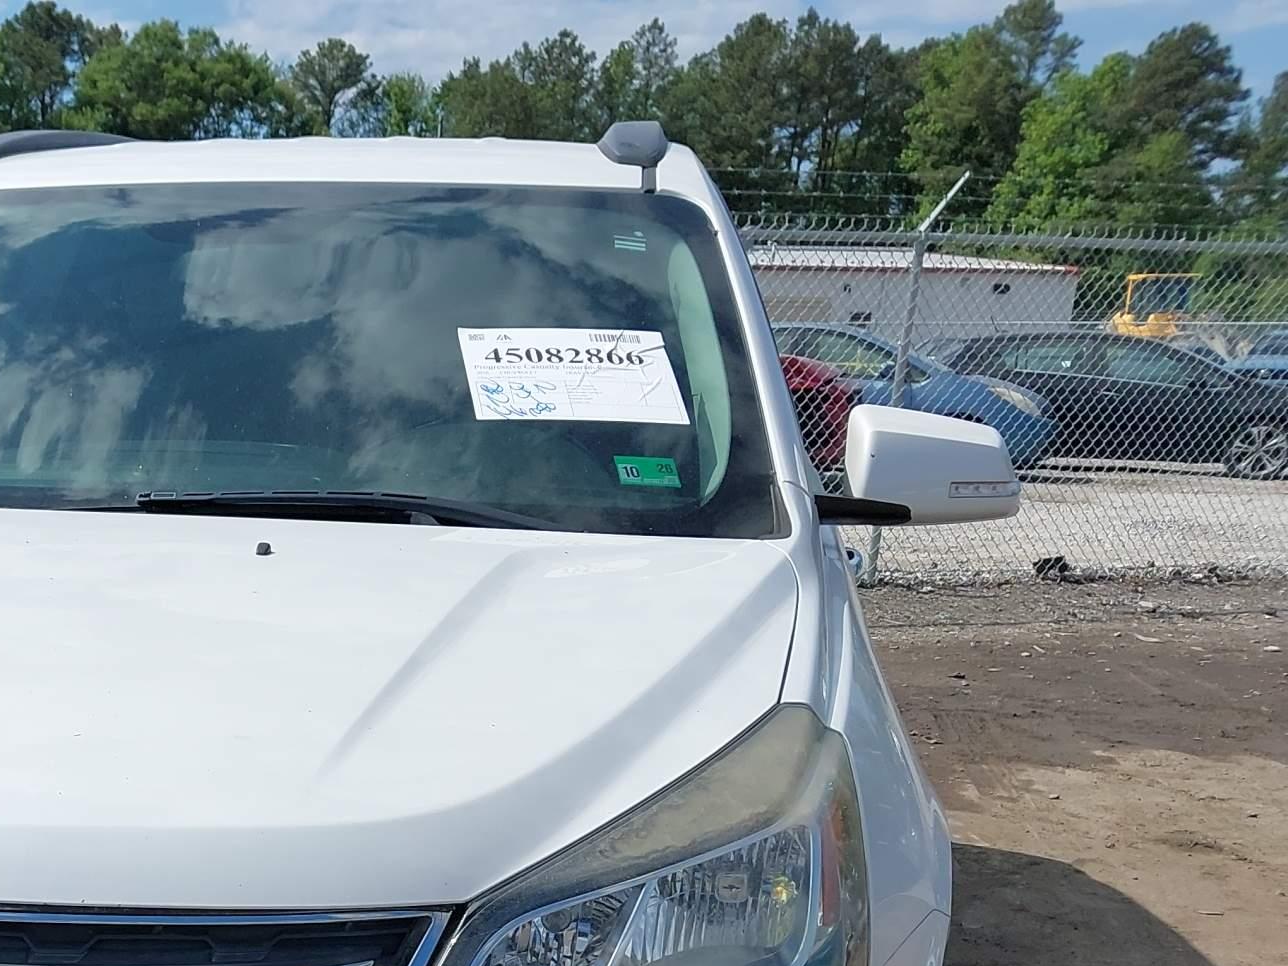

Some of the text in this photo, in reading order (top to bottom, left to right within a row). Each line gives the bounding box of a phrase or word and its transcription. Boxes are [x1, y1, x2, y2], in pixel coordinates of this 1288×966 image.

[484, 347, 645, 366] 45082866
[622, 463, 674, 479] 10 26
